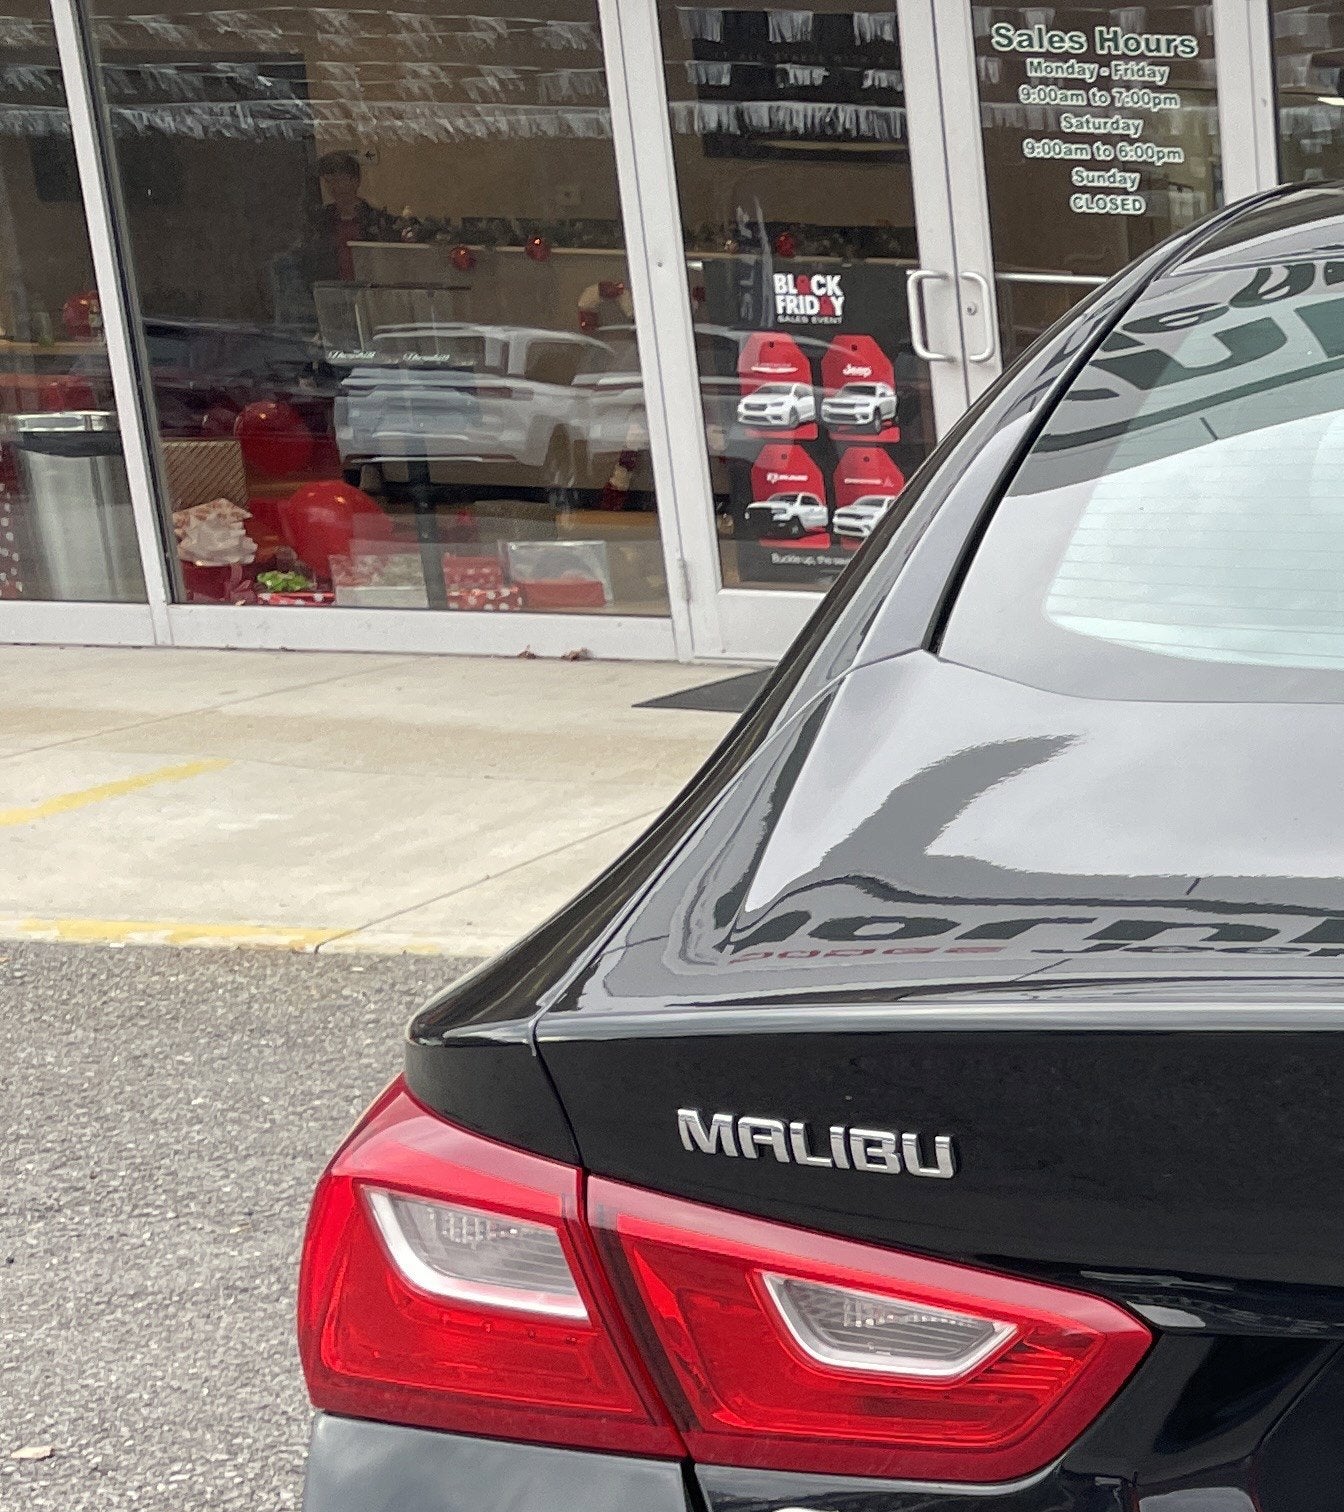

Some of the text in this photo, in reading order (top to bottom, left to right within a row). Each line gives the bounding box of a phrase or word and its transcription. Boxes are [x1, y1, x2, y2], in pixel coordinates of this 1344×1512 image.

[991, 22, 1199, 57] Sales Hours
[1026, 58, 1098, 82] Monday
[1110, 60, 1170, 85] Friday
[1018, 84, 1181, 112] 9:00am to 7:00pm
[1060, 113, 1144, 138] Saturday
[1022, 138, 1184, 166] 9:00am to 6:00pm
[1071, 166, 1141, 192] Sunday
[1070, 194, 1147, 216] CLOSED
[677, 1108, 954, 1179] MALIBU
